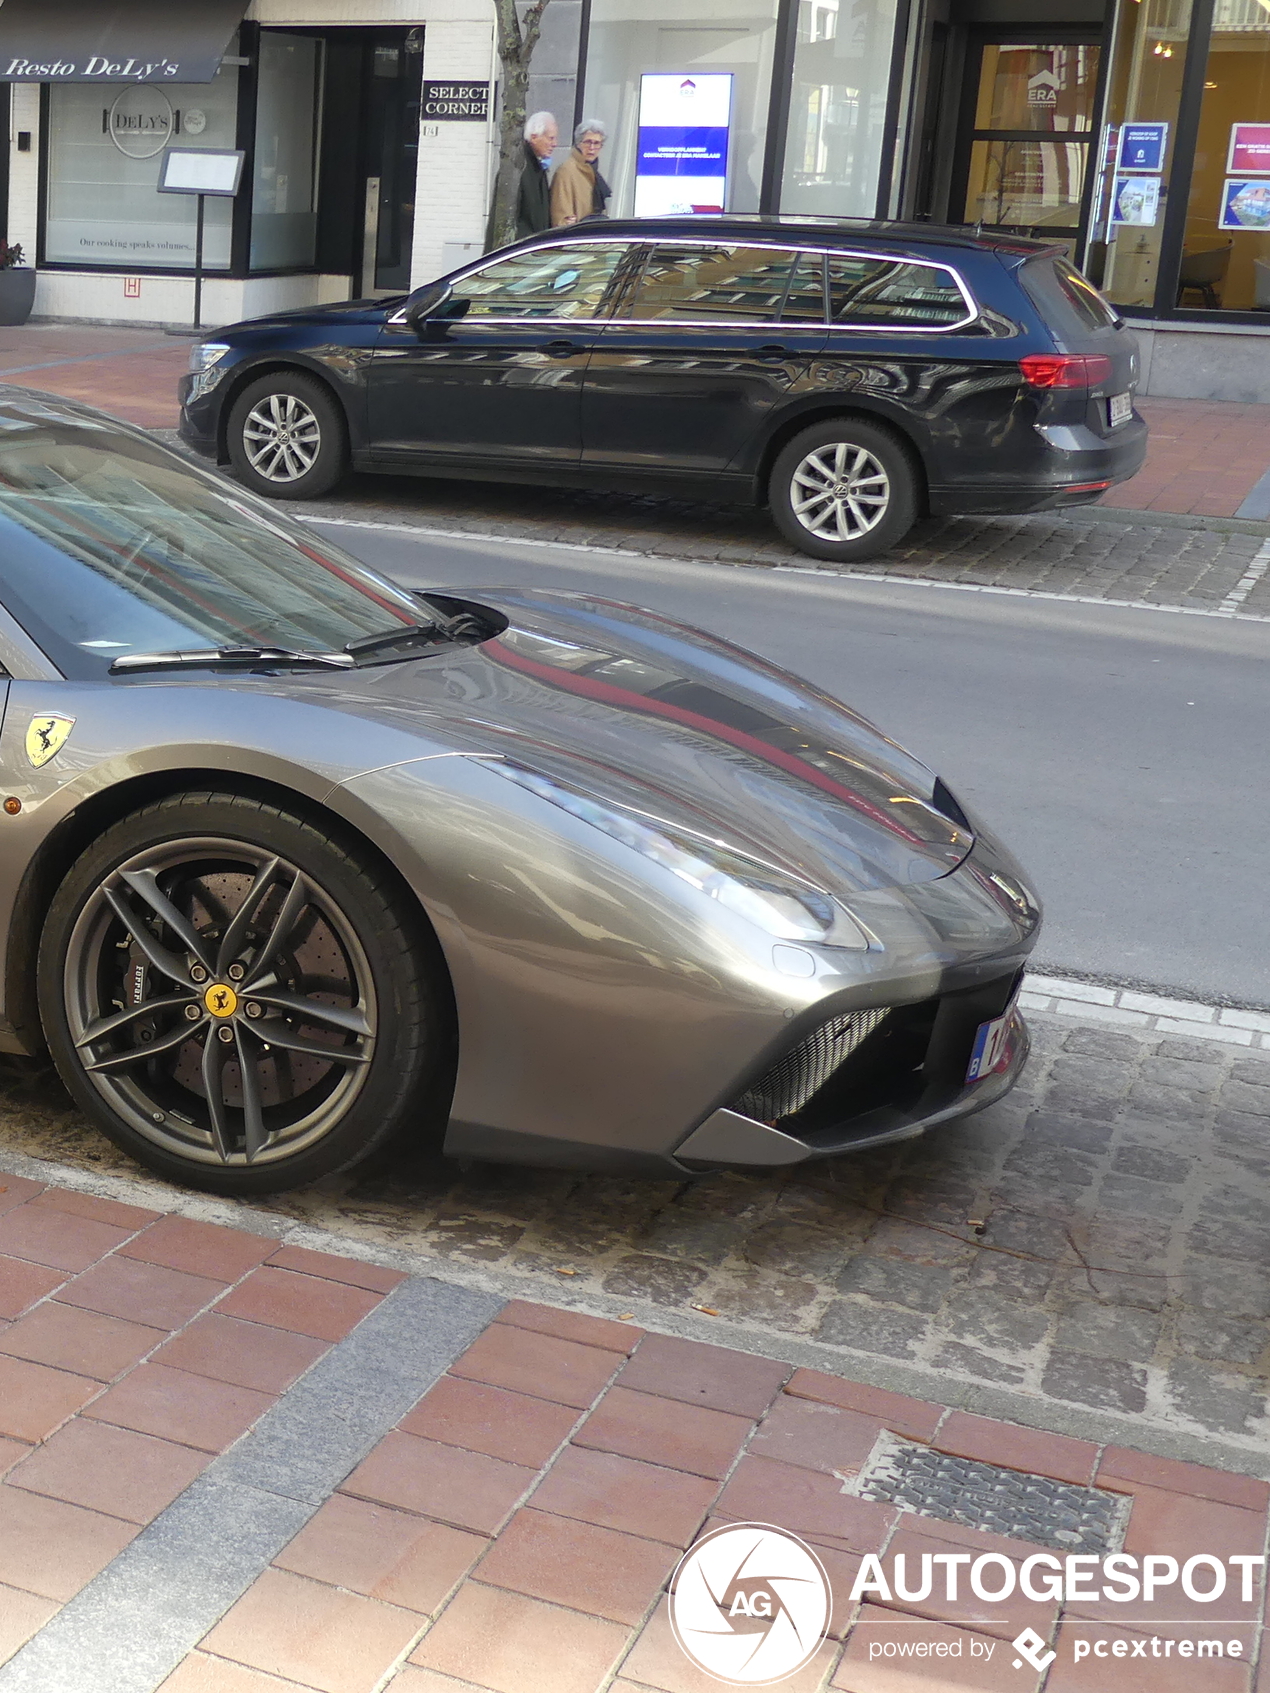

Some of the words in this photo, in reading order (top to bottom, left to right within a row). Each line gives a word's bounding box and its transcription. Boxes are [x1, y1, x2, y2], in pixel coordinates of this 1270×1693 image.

[2, 58, 76, 76] Resto
[80, 56, 180, 80] DeLy's
[428, 86, 490, 99] SELECT
[1028, 89, 1057, 100] ERA
[79, 237, 95, 247] Our
[96, 238, 128, 249] cooking
[129, 240, 155, 250] speaks
[127, 277, 137, 293] H
[969, 1057, 980, 1077] B
[987, 1028, 1000, 1067] 1
